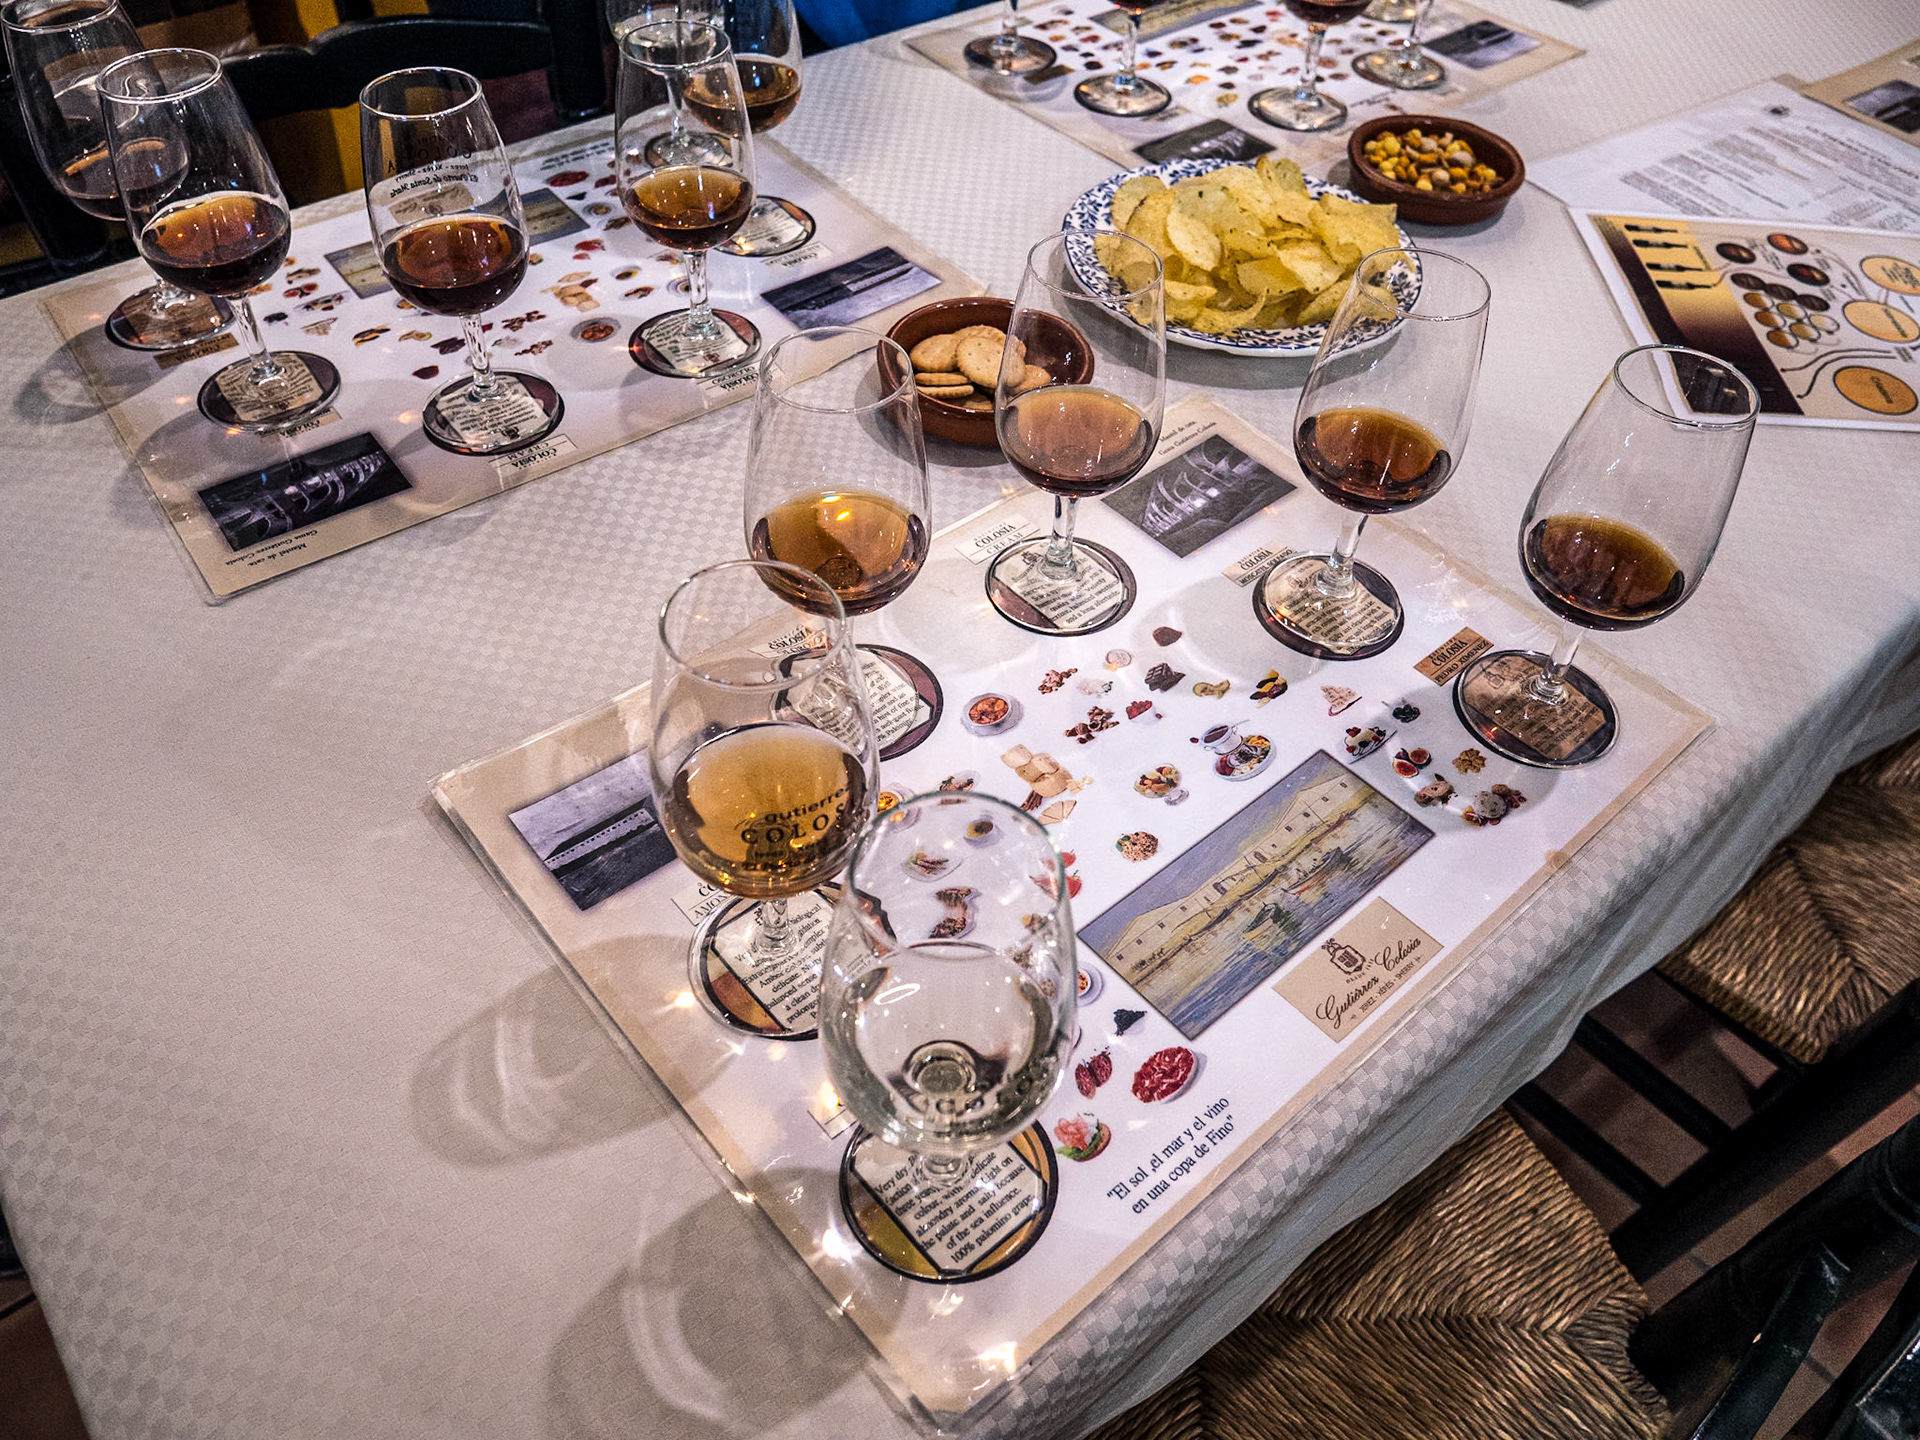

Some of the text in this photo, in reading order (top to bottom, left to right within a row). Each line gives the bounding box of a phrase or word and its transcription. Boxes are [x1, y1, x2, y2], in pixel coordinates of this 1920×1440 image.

[506, 443, 549, 461] CREAM
[511, 448, 557, 468] COLOSIA
[975, 525, 1016, 548] COLOSIA
[986, 532, 1023, 557] CREAM
[279, 543, 307, 557] Mantel
[1240, 550, 1273, 570] COLOSIA
[1238, 565, 1269, 585] MOSCATEL
[1431, 640, 1468, 666] COLOSIA
[1434, 663, 1459, 683] PEDRO
[772, 973, 802, 993] delicate.
[1359, 996, 1377, 1013] JEREZ
[1394, 961, 1415, 980] SHERRY
[790, 992, 811, 1007] clean
[1128, 1166, 1149, 1188] sol
[1161, 1135, 1186, 1159] mar
[1183, 1127, 1194, 1141] y
[1192, 1116, 1206, 1131] el
[1203, 1097, 1230, 1120] vino
[1001, 1156, 1013, 1167] on
[875, 1177, 897, 1195] Very
[1132, 1198, 1150, 1214] en
[1146, 1179, 1171, 1200] una
[1168, 1155, 1197, 1182] copa
[1193, 1144, 1210, 1159] de
[894, 1199, 916, 1217] three
[935, 1219, 960, 1242] palate
[960, 1205, 976, 1221] and
[946, 1188, 1022, 1250] of the sea influence.
[950, 1242, 975, 1263] 100%
[975, 1213, 1011, 1247] palomino
